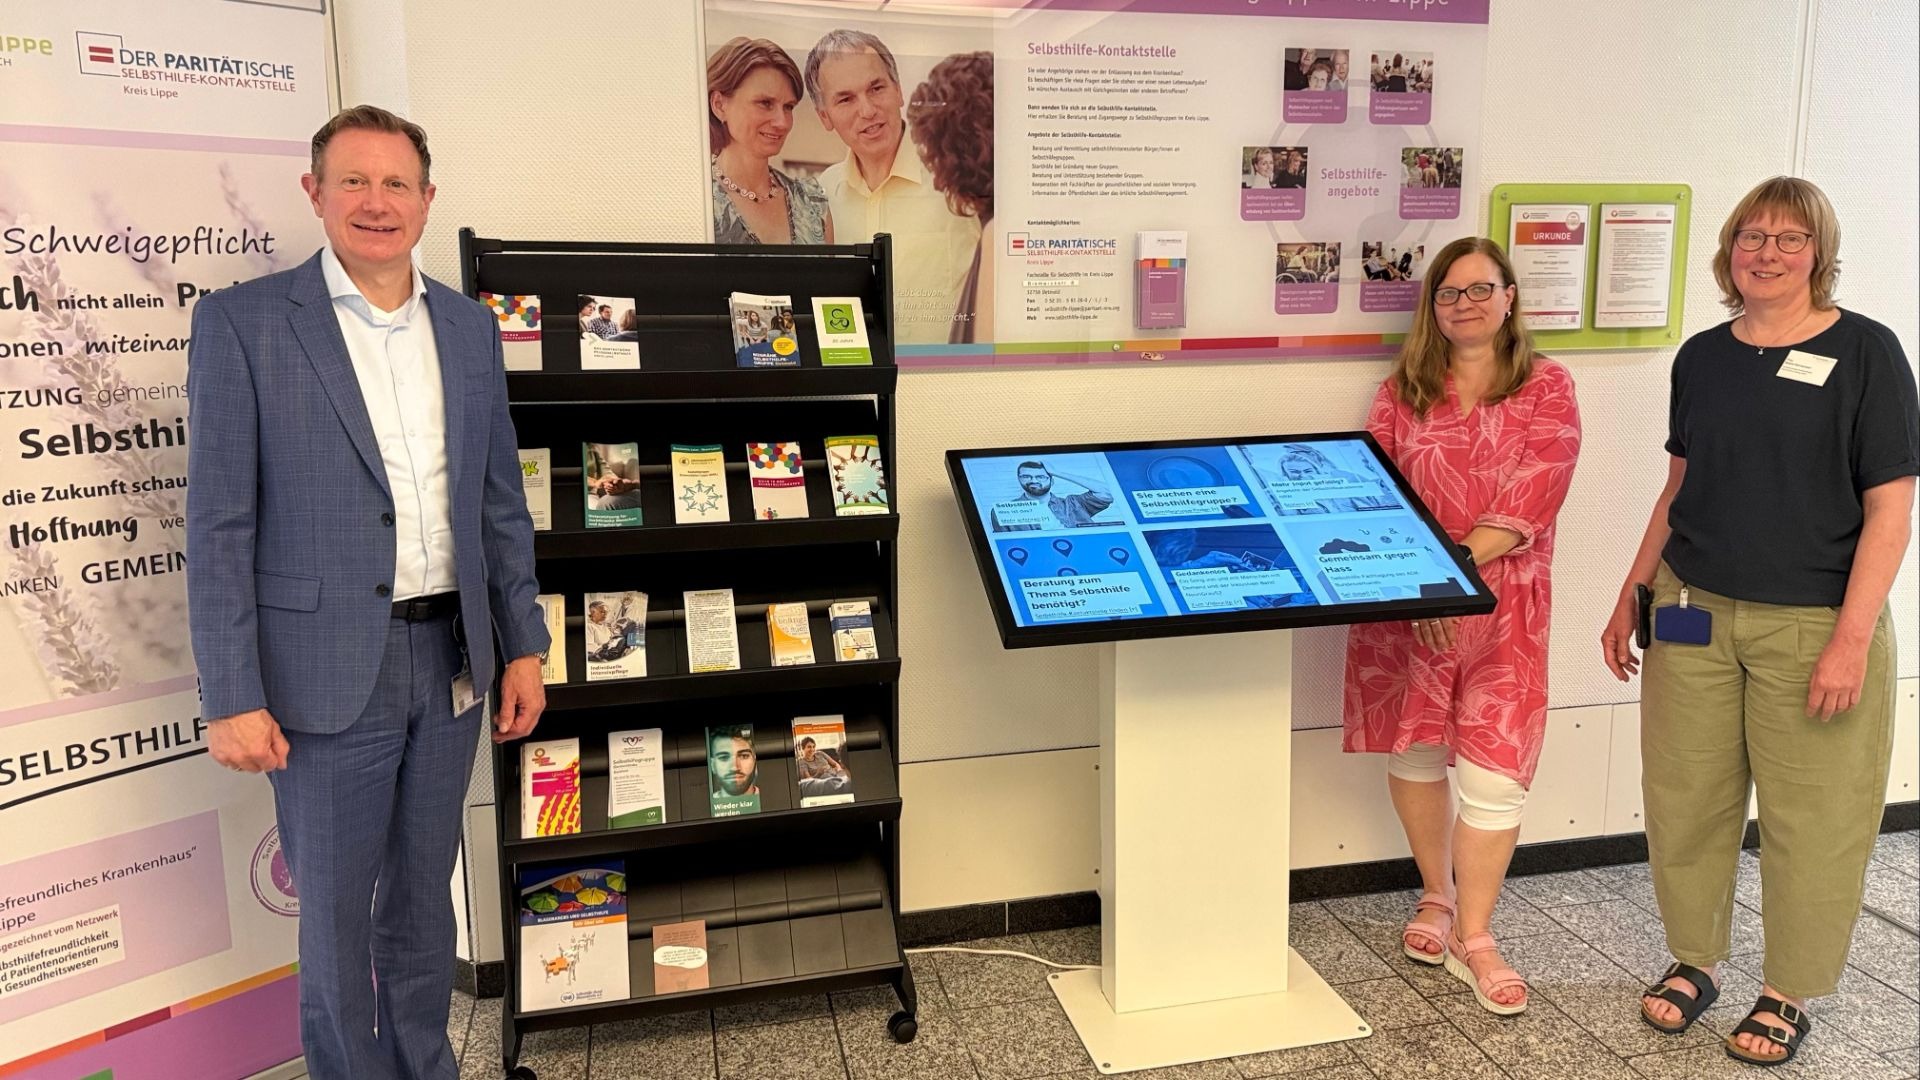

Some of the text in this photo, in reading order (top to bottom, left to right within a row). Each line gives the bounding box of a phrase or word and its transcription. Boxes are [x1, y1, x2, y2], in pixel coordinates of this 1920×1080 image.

[1027, 42, 1177, 59] Selbsthilfe-Kontaktstelle
[119, 49, 295, 81] DER PARITÄTISCHE
[121, 68, 296, 93] SELBSTHILFE-KONTAKTSTELLE
[123, 85, 179, 99] Kreis Lippe
[1320, 167, 1387, 181] Selbsthilfe-
[1327, 186, 1380, 199] angebote
[3, 225, 276, 264] Schweigepflicht
[1027, 238, 1116, 249] DER PARITÄTISCHE
[1532, 232, 1572, 241] URKUNDE
[57, 294, 109, 310] nicht
[113, 292, 164, 309] allein
[0, 341, 63, 358] onen
[97, 382, 189, 408] gemeins
[19, 418, 187, 459] Selbsthi
[2, 476, 188, 506] die Zukunft schau
[1136, 488, 1217, 500] Sie suchen eine
[1140, 496, 1238, 508] Selbsthilfegruppe?
[9, 516, 185, 549] Hoffnung we
[1319, 552, 1417, 563] Gemeinsam gegen
[1023, 577, 1102, 588] Beratung zum
[1027, 585, 1131, 599] Thema Selbsthilfe
[1031, 599, 1087, 610] benötigt?
[714, 800, 753, 810] Wieder klar
[714, 809, 740, 817] werden
[0, 911, 36, 931] ippe
[0, 909, 119, 954] gezeichnet vom Netzwerk
[10, 939, 119, 981] Patientenorientierung
[5, 957, 99, 993] Gesundheitswesen
